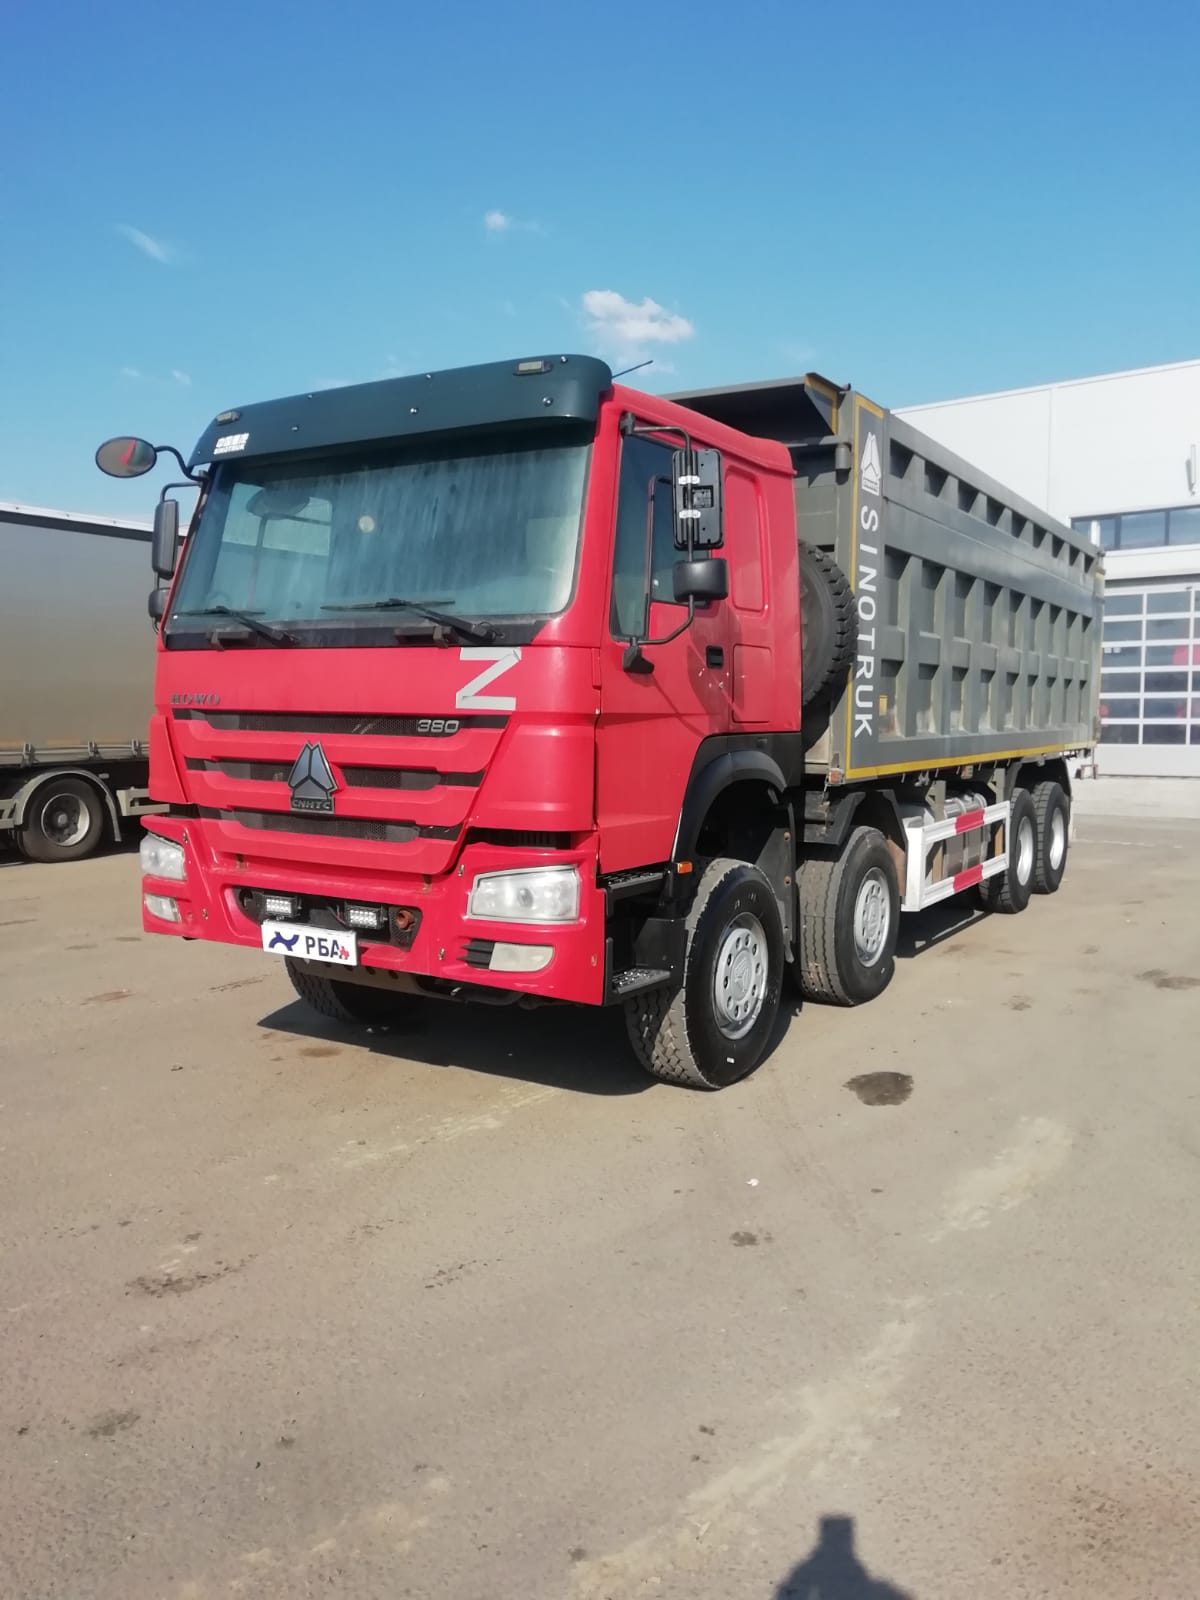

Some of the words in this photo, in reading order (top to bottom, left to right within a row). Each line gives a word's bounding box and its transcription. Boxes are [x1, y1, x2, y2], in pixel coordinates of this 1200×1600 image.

[855, 505, 879, 738] SINOTRUK
[456, 646, 521, 711] Z
[171, 693, 221, 705] HOWO
[417, 719, 460, 733] 380
[305, 935, 342, 960] РБА
